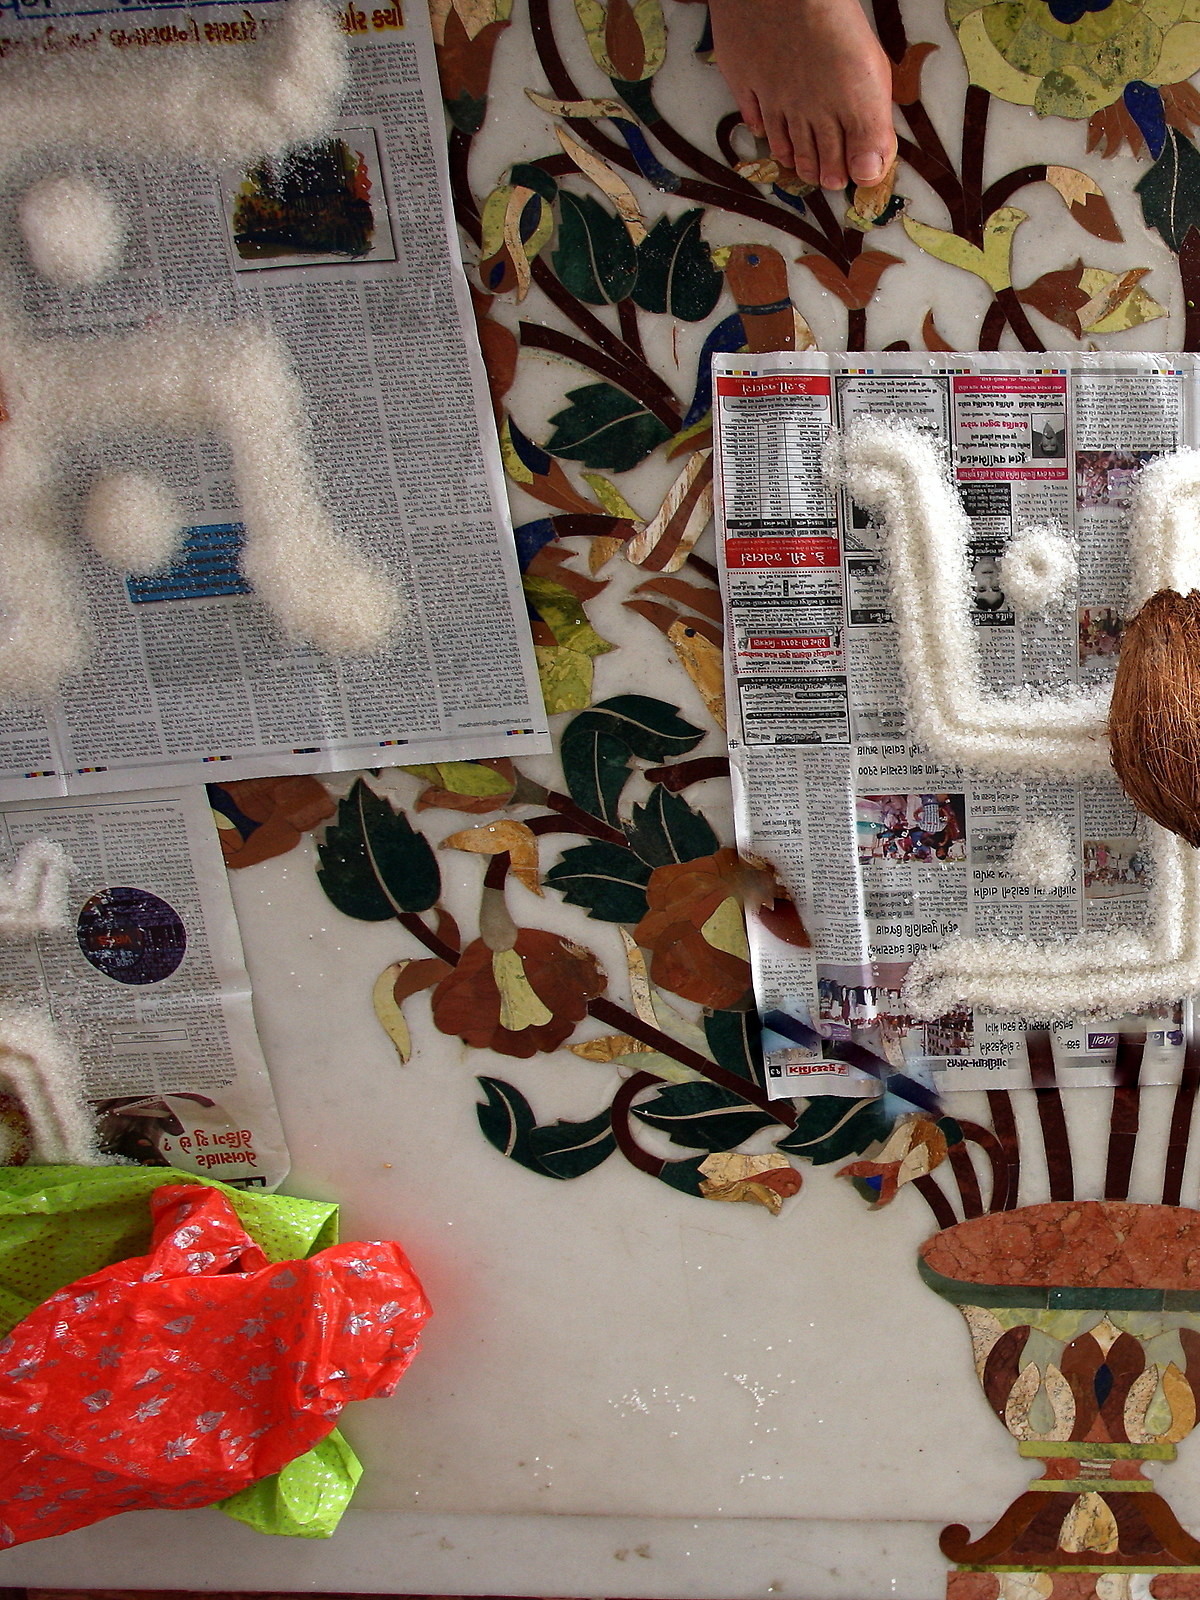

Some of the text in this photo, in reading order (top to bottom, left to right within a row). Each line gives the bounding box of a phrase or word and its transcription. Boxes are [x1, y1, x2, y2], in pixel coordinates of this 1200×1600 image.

[960, 454, 1006, 466] વર્ષાભિનંદન
[740, 552, 782, 566] જ્વેલર્સ
[882, 745, 906, 758] દવાઓ
[910, 765, 923, 776] કથા
[974, 886, 1030, 900] કરાટેની તાલીમ
[904, 920, 938, 938] પુણ્યતિથિ
[946, 1058, 1008, 1070] ગાંધીધામ-અંજાર
[179, 1136, 192, 1154] છે
[194, 1130, 209, 1151] શું
[212, 1130, 252, 1149] હેકિંગ
[196, 1152, 258, 1169] વેબસાઈટ
